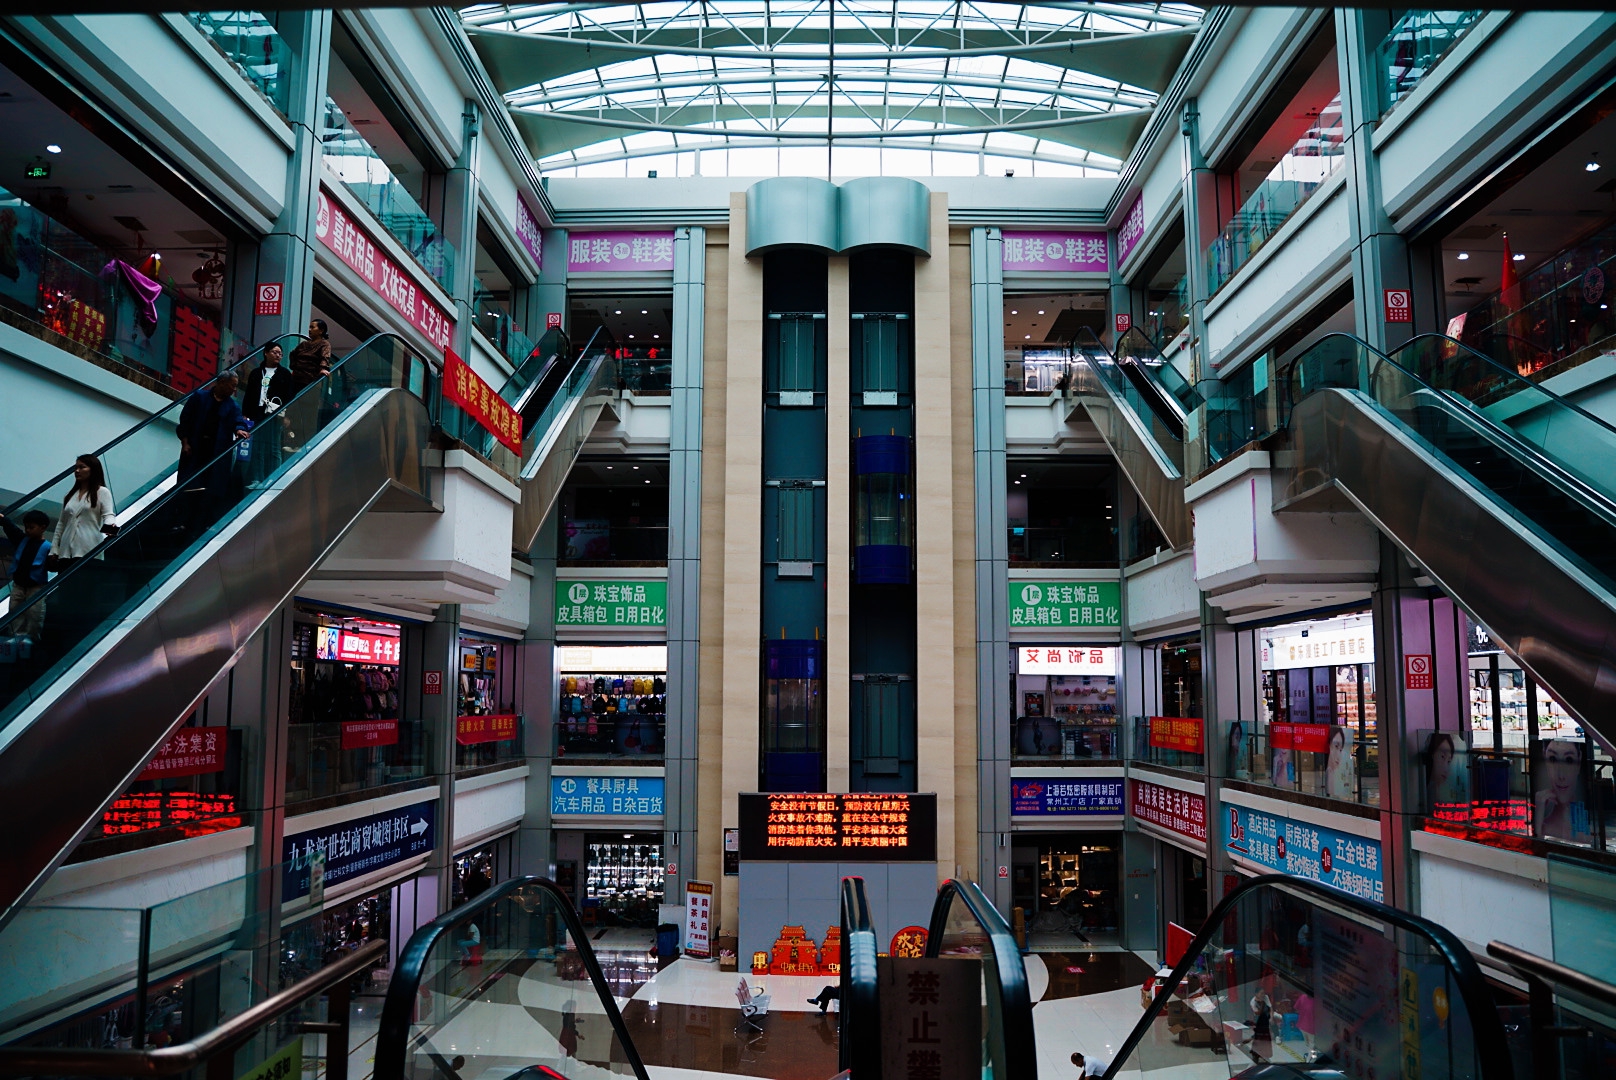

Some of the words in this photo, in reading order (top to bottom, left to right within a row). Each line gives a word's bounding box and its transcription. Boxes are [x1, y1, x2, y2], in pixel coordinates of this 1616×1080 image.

[571, 239, 611, 263] 服装
[632, 238, 673, 263] 鞋类
[1004, 239, 1044, 263] 服装
[1065, 238, 1107, 263] 鞋类
[333, 209, 374, 283] 喜庆用品
[381, 259, 416, 322] 文体玩具
[420, 299, 449, 350] 工艺礼品
[594, 585, 646, 603] 珠宝饰品
[1047, 586, 1099, 604] 珠宝饰品
[557, 605, 608, 623] 皮具箱包
[615, 606, 664, 623] 日用日化
[1012, 606, 1062, 624] 皮具箱包
[1069, 606, 1118, 624] 日用日化
[1026, 648, 1104, 664] 艾尚饰品
[587, 778, 639, 794] 餐具厨具
[554, 796, 605, 813] 汽车用品
[612, 796, 662, 813] 日杂百货
[1248, 813, 1277, 839] 酒店用品
[1286, 823, 1320, 853] 厨房设备
[1335, 838, 1377, 871] 五金电器
[1248, 838, 1278, 866] 茶具餐具
[1286, 850, 1320, 881] 紫砂陶瓷
[1332, 868, 1384, 903] 不锈钢制品
[690, 920, 708, 931] 礼品
